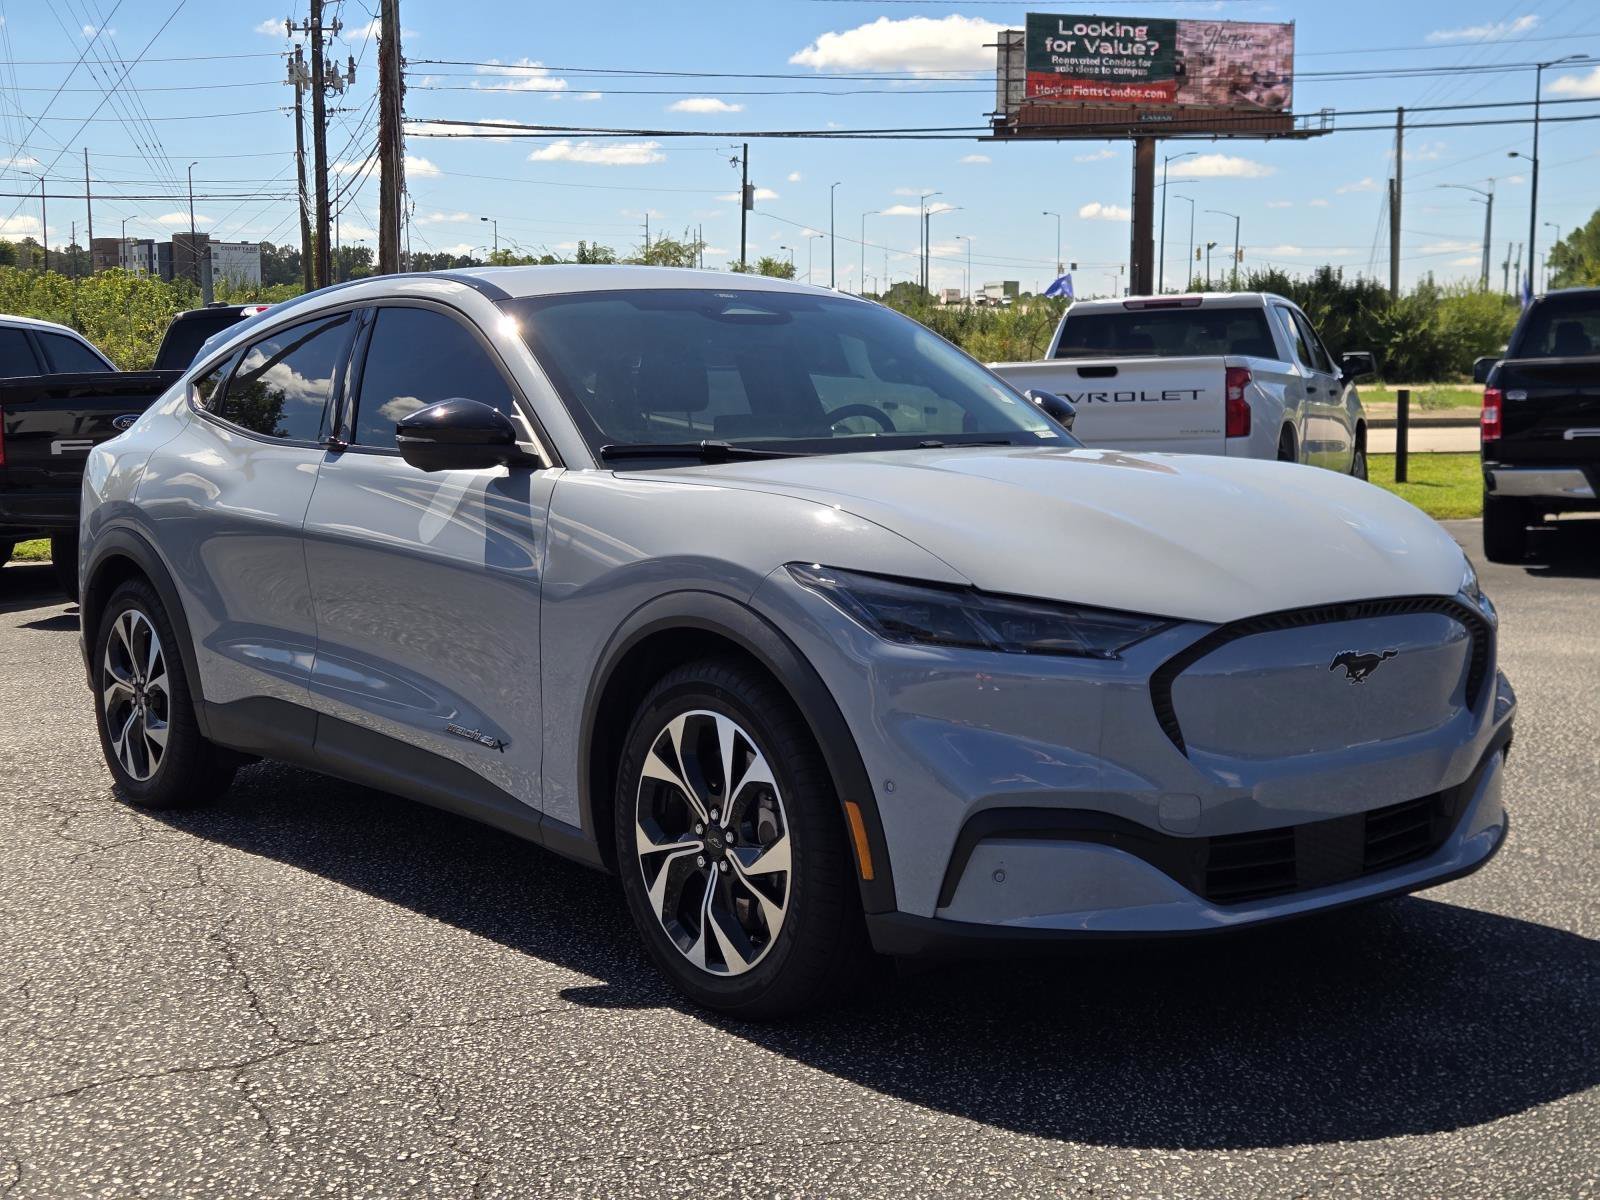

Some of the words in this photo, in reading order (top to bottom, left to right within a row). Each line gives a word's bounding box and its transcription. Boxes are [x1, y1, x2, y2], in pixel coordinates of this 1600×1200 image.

[1058, 19, 1149, 41] Looking
[1045, 37, 1076, 53] for
[1083, 38, 1160, 56] Value?
[1051, 55, 1101, 66] Renovated
[1102, 57, 1136, 67] Condos
[1138, 59, 1153, 67] for
[1055, 65, 1074, 73] sale
[1101, 66, 1111, 75] to
[1113, 67, 1148, 77] campus
[1055, 389, 1206, 403] VROLET
